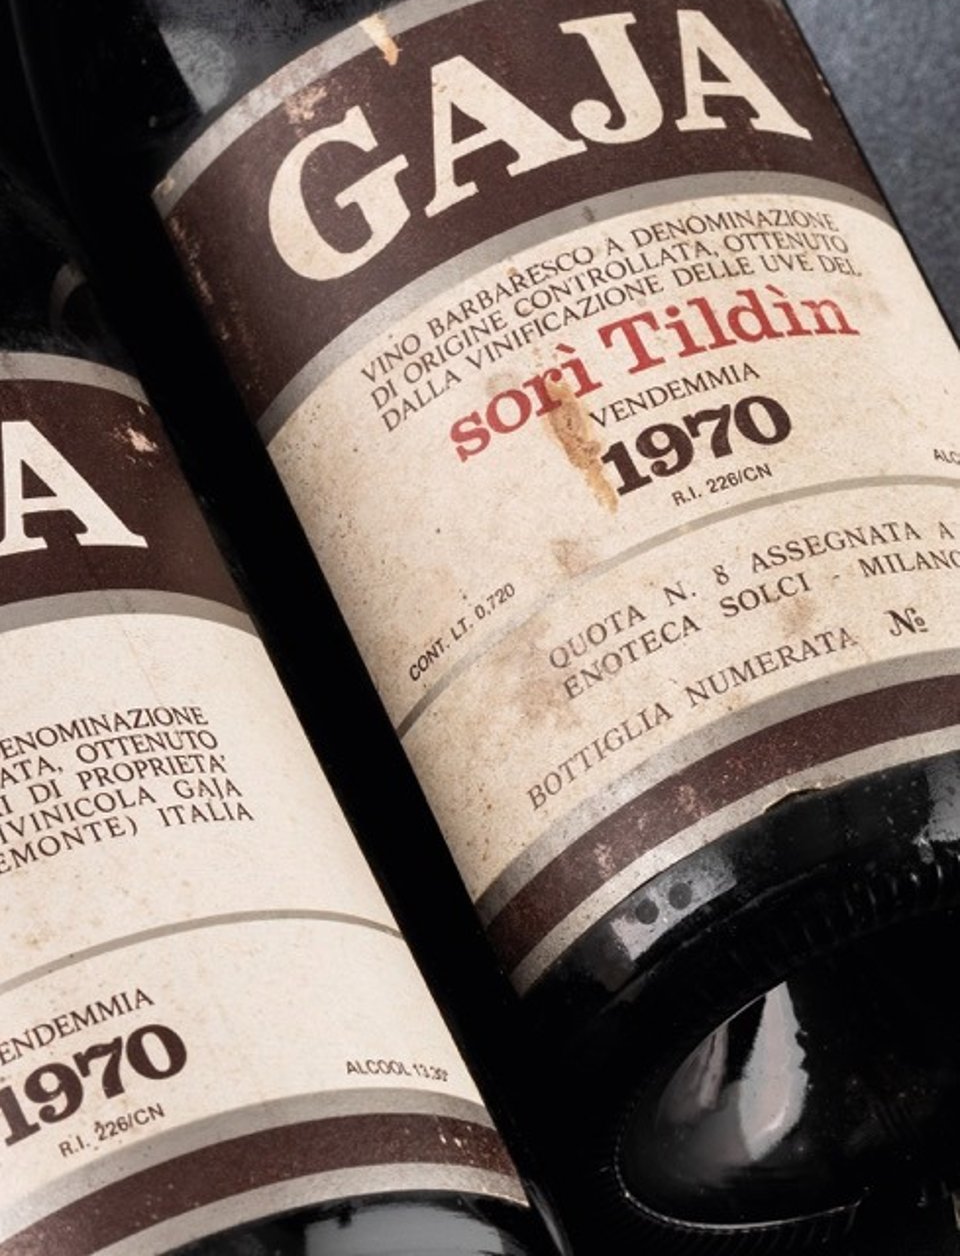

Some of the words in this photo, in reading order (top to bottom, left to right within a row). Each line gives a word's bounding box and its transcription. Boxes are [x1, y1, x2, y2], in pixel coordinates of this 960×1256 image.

[268, 9, 813, 282] GAJA
[361, 333, 421, 384] VINO
[427, 245, 595, 339] BARBARESCO
[606, 237, 625, 257] A
[630, 208, 840, 247] DENOMINAZIONE
[371, 379, 398, 412] DI
[403, 310, 508, 385] ORIGINE
[514, 240, 720, 320] CONTROLLATA,
[723, 231, 849, 255] OTTENUTO
[380, 368, 462, 433] DALLA
[465, 275, 665, 372] VINIFICAZIONE
[672, 255, 756, 288] DELLE
[760, 253, 814, 274] UVE
[449, 343, 603, 464] sorì
[597, 284, 861, 375] Tildìn
[588, 361, 761, 429] VENDEMMIA
[600, 394, 793, 496] 1970
[672, 482, 702, 506] R.I.
[706, 462, 773, 495] 226/CN
[408, 637, 450, 682] CONT.
[449, 616, 474, 641] LT.
[474, 582, 516, 620] 0,720
[548, 603, 648, 670] QUOTA
[662, 580, 697, 608] N.
[714, 564, 731, 587] 8
[750, 520, 922, 575] ASSEGNATA
[938, 521, 955, 541] A
[561, 613, 702, 701] ENOTECA
[719, 571, 812, 619] SOLCI
[75, 729, 218, 765] OTTENUTO
[525, 701, 675, 813] BOTTIGLIA
[683, 626, 860, 709] NUMERATA
[28, 779, 63, 806] DI
[157, 802, 255, 828] ITALIA
[173, 776, 244, 802] GAJA
[346, 1059, 412, 1076] ALCOOL
[58, 1135, 90, 1158] R.I.
[94, 1102, 166, 1142] 226/CN
